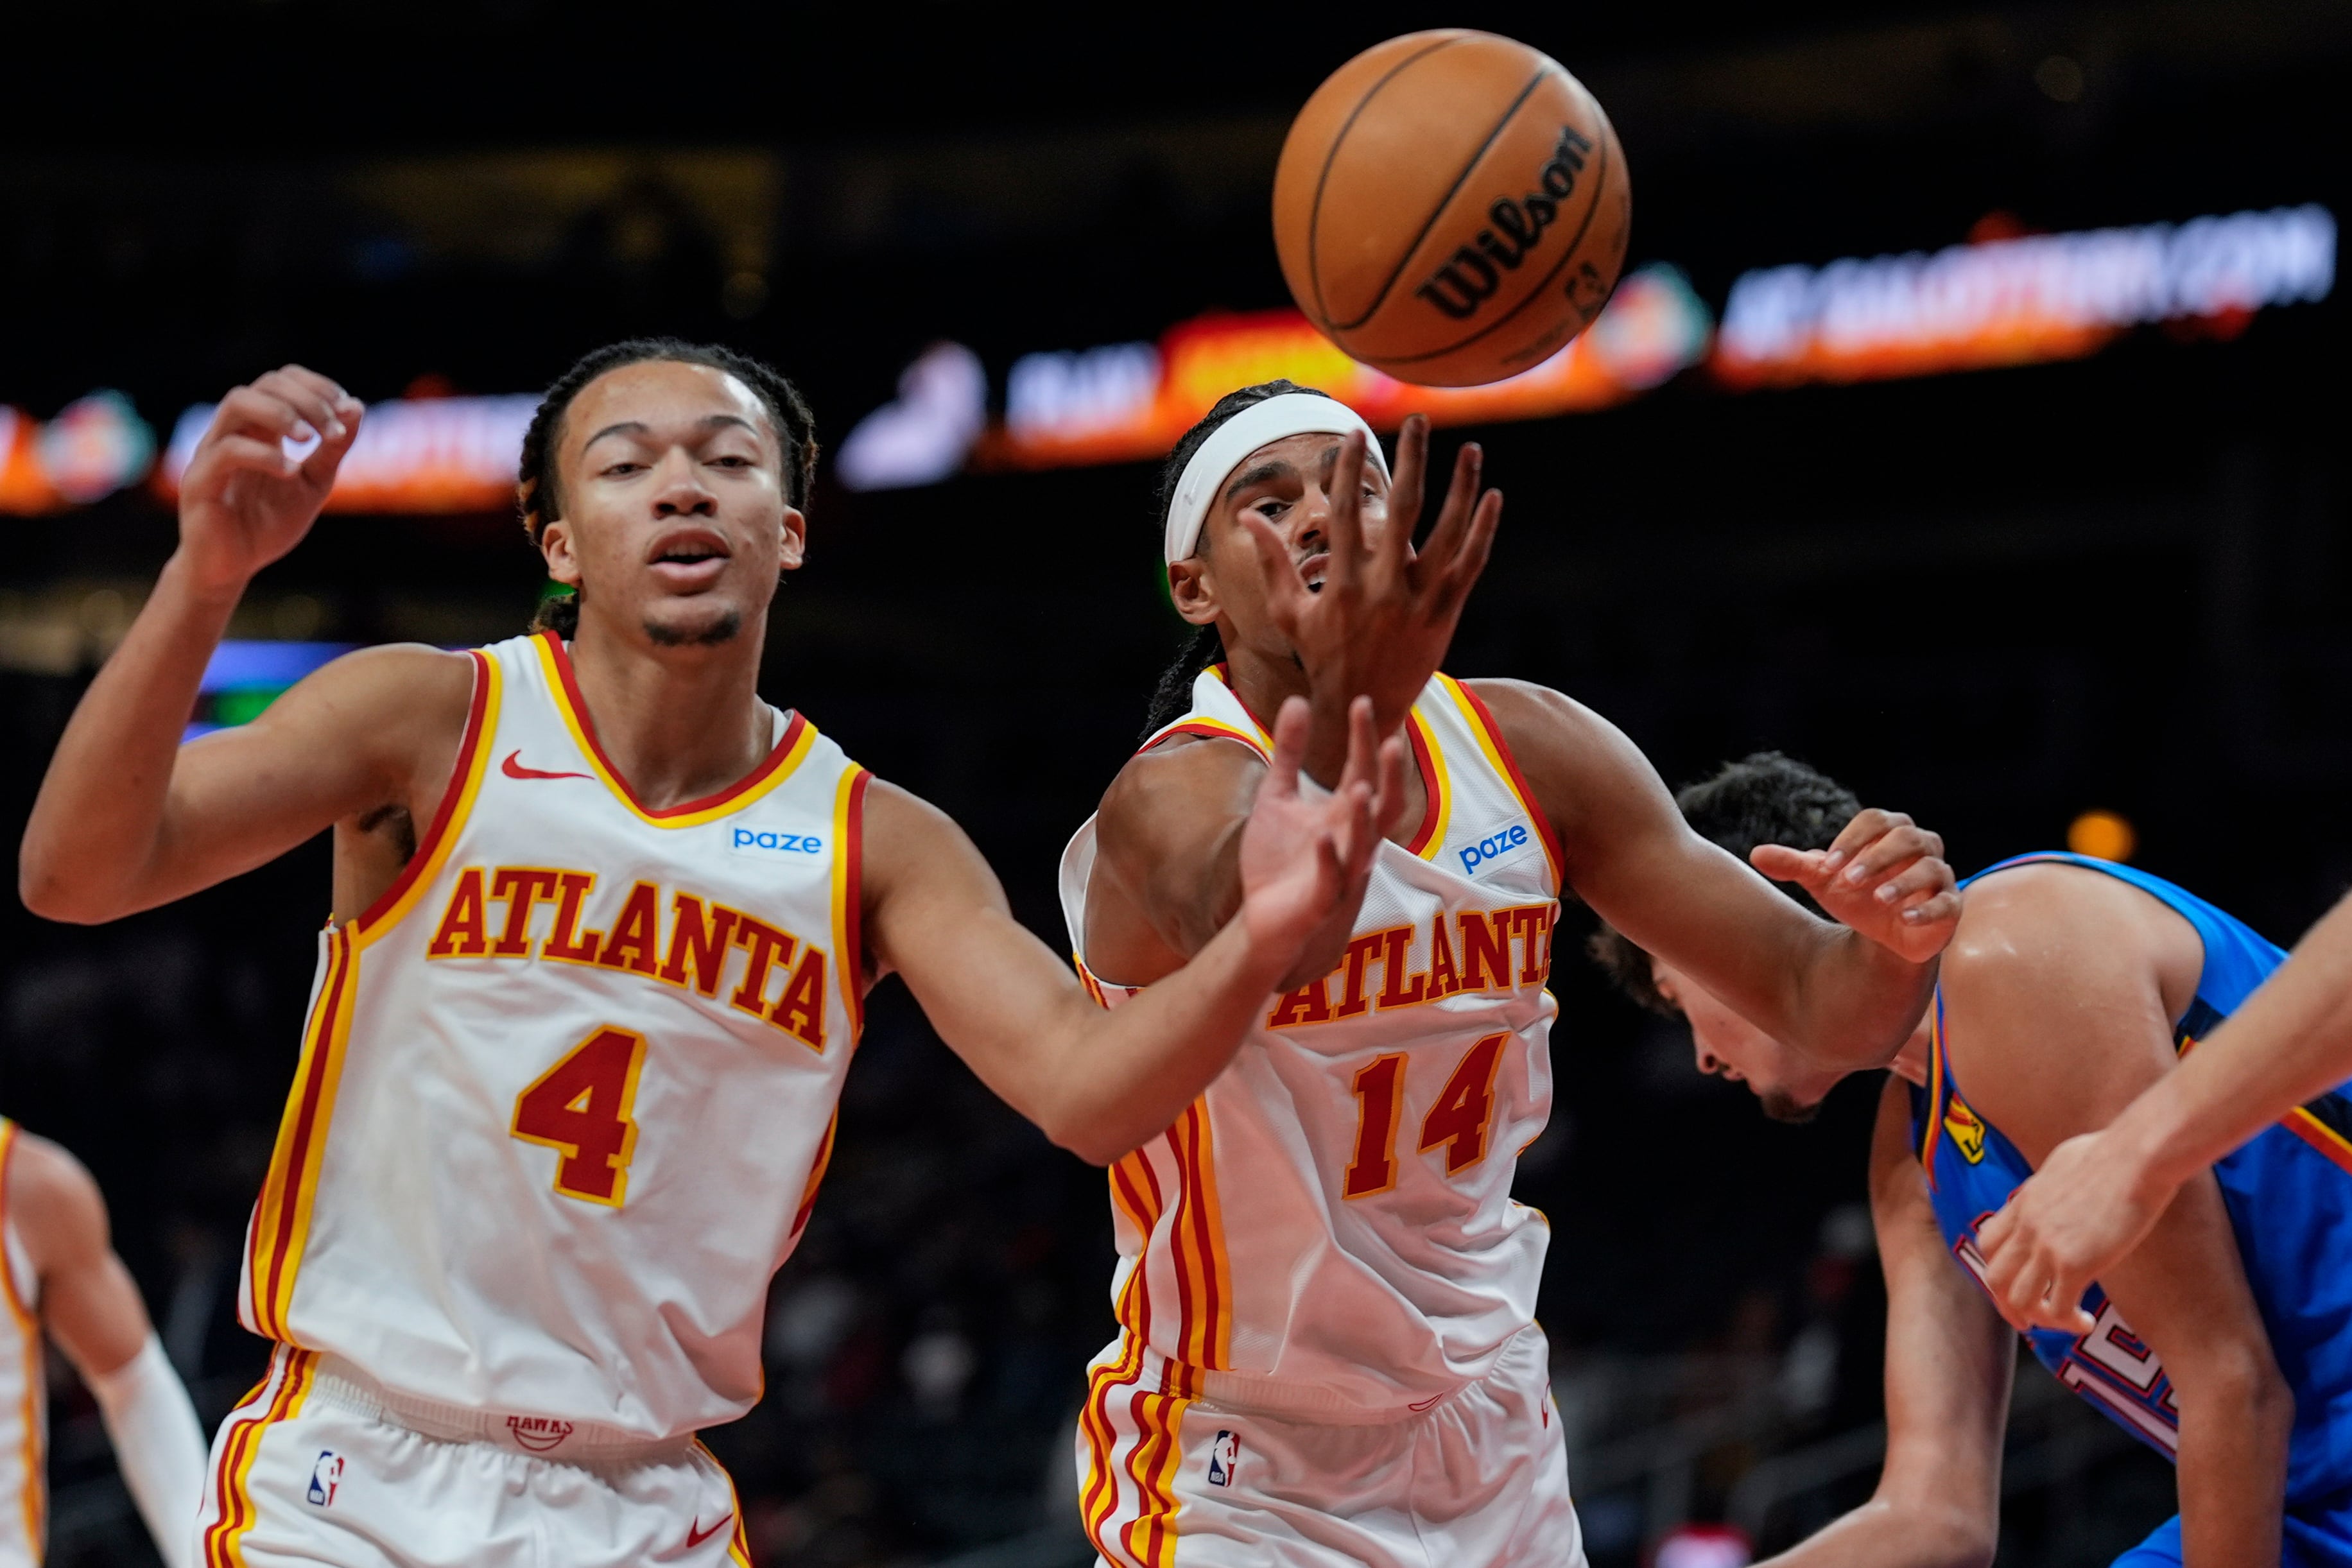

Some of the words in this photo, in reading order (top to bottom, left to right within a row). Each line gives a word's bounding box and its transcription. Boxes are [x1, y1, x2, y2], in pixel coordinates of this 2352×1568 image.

[1415, 126, 1591, 320] Wilson
[734, 828, 822, 854] paze
[1459, 825, 1528, 874] paze
[426, 866, 828, 1055] ATLANTA
[1265, 901, 1558, 1031] ATLANT
[510, 1023, 648, 1209] 4
[1342, 1031, 1511, 1200] 14
